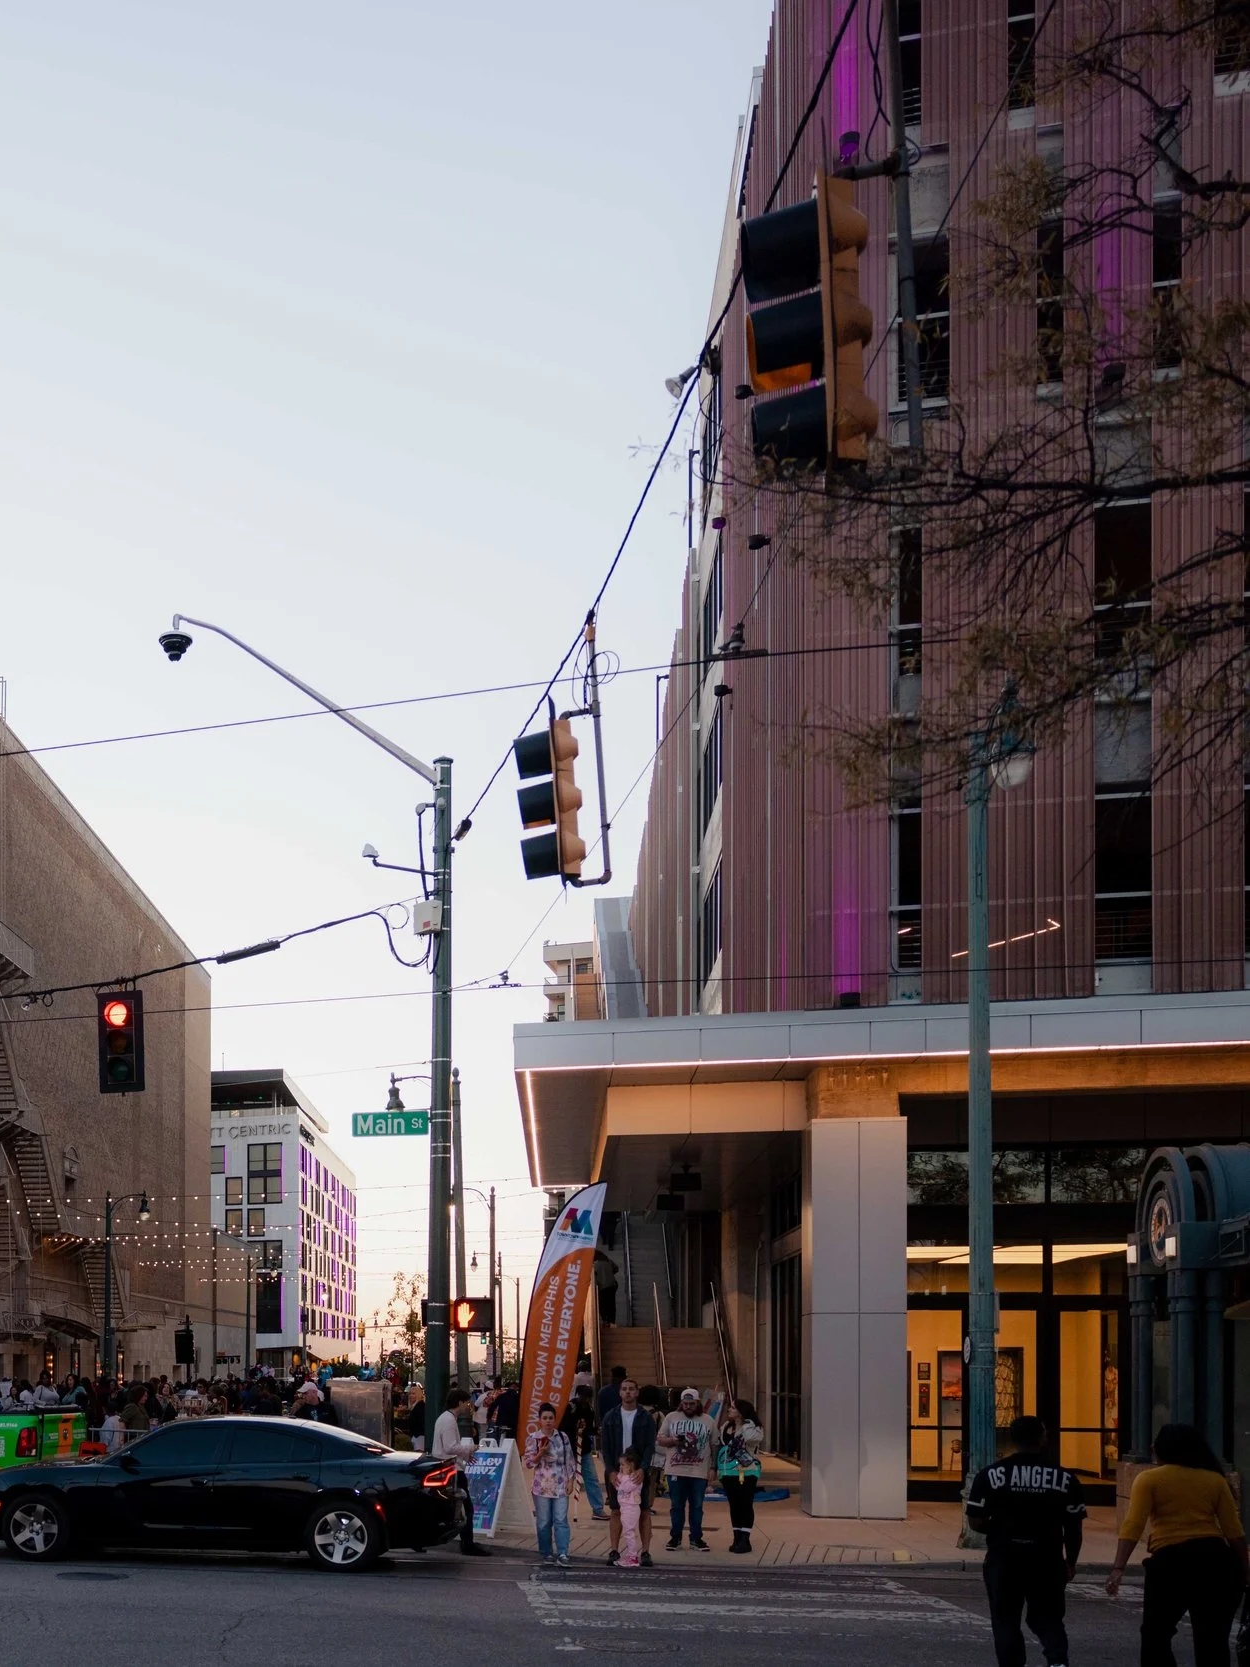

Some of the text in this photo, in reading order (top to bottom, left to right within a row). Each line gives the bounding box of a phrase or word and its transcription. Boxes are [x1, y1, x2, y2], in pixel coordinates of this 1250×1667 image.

[228, 1123, 292, 1140] CENTRIC
[357, 1114, 424, 1135] Main St
[556, 1259, 582, 1350] EVERYONE.
[526, 1275, 560, 1435] OWNTOWN MEMPHIS
[551, 1351, 566, 1389] FOR
